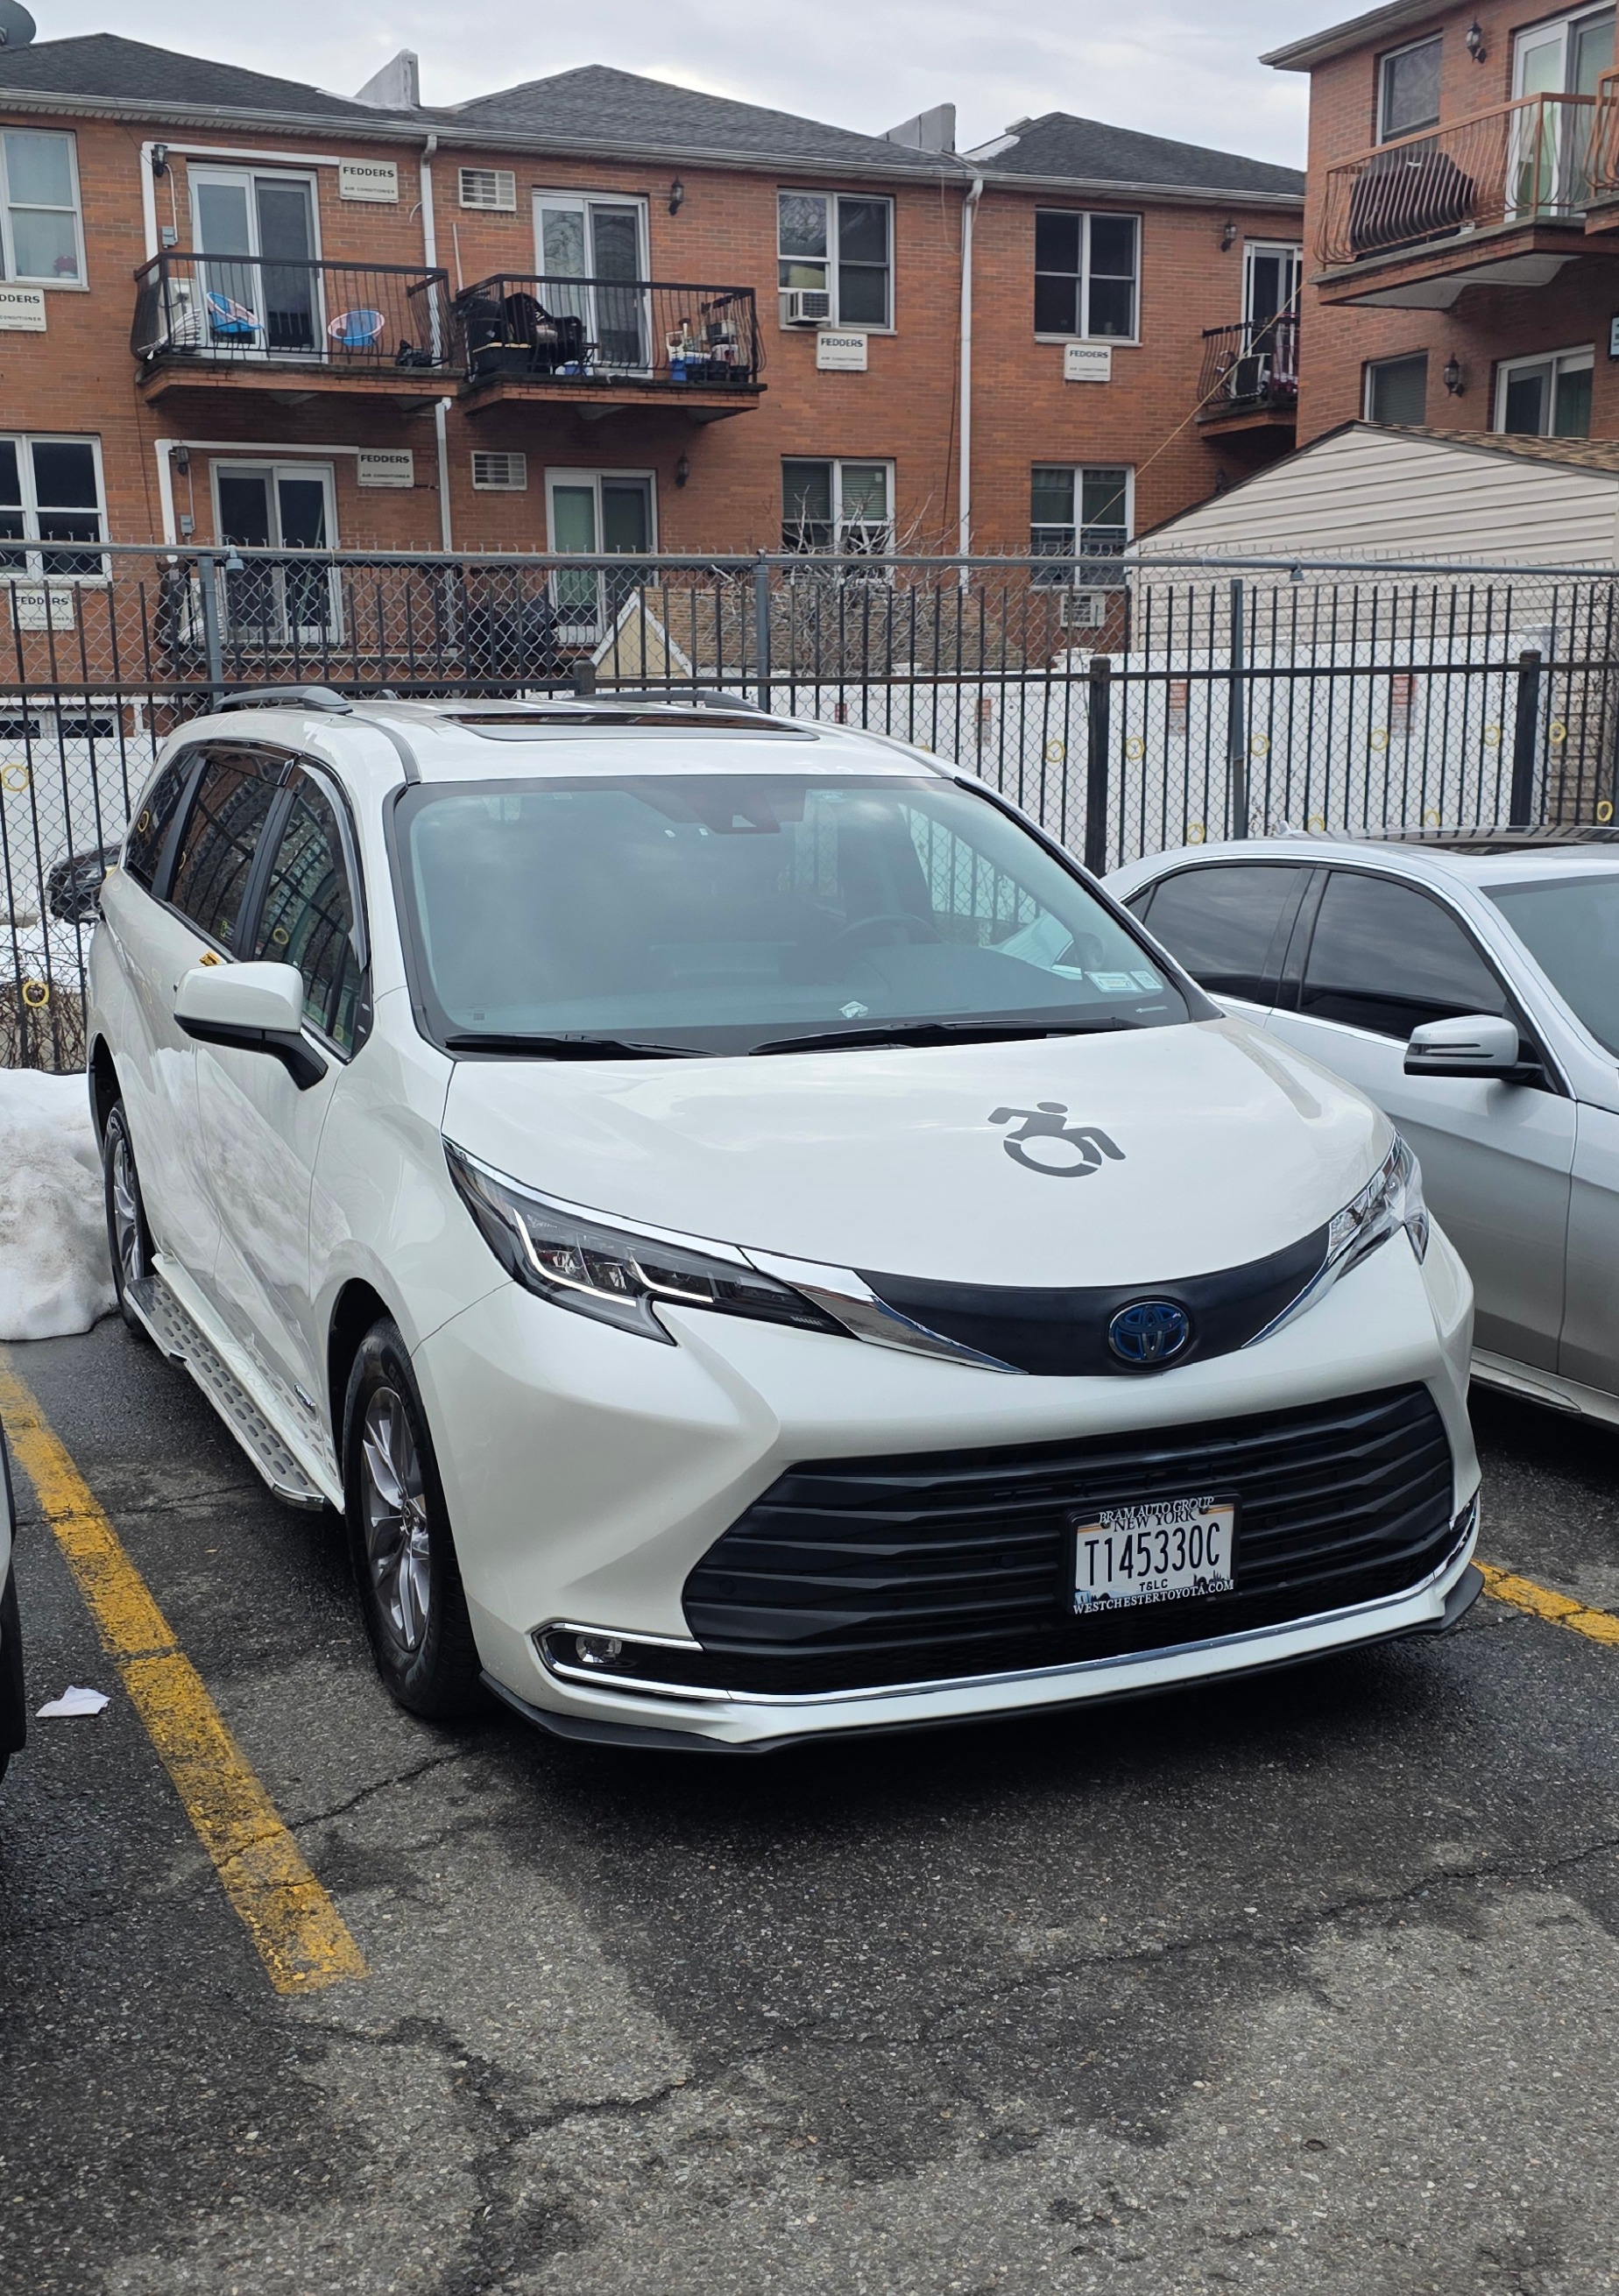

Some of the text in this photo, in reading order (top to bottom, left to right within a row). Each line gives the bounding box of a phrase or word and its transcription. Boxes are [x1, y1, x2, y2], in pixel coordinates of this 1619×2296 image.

[343, 166, 394, 178] FEDDERS
[821, 337, 864, 348] FEDDERS
[1070, 350, 1109, 359] FEDDERS
[360, 455, 410, 463] FEDDERS
[15, 597, 69, 606] FEDDRS
[1099, 1496, 1215, 1524] BRAM AUTO GROUP
[1114, 1508, 1197, 1532] NEW YORK
[1084, 1522, 1220, 1586] T145330C
[1138, 1579, 1169, 1593] T&LC
[1072, 1579, 1234, 1615] WESTCHESTERTOYOTA.COM
